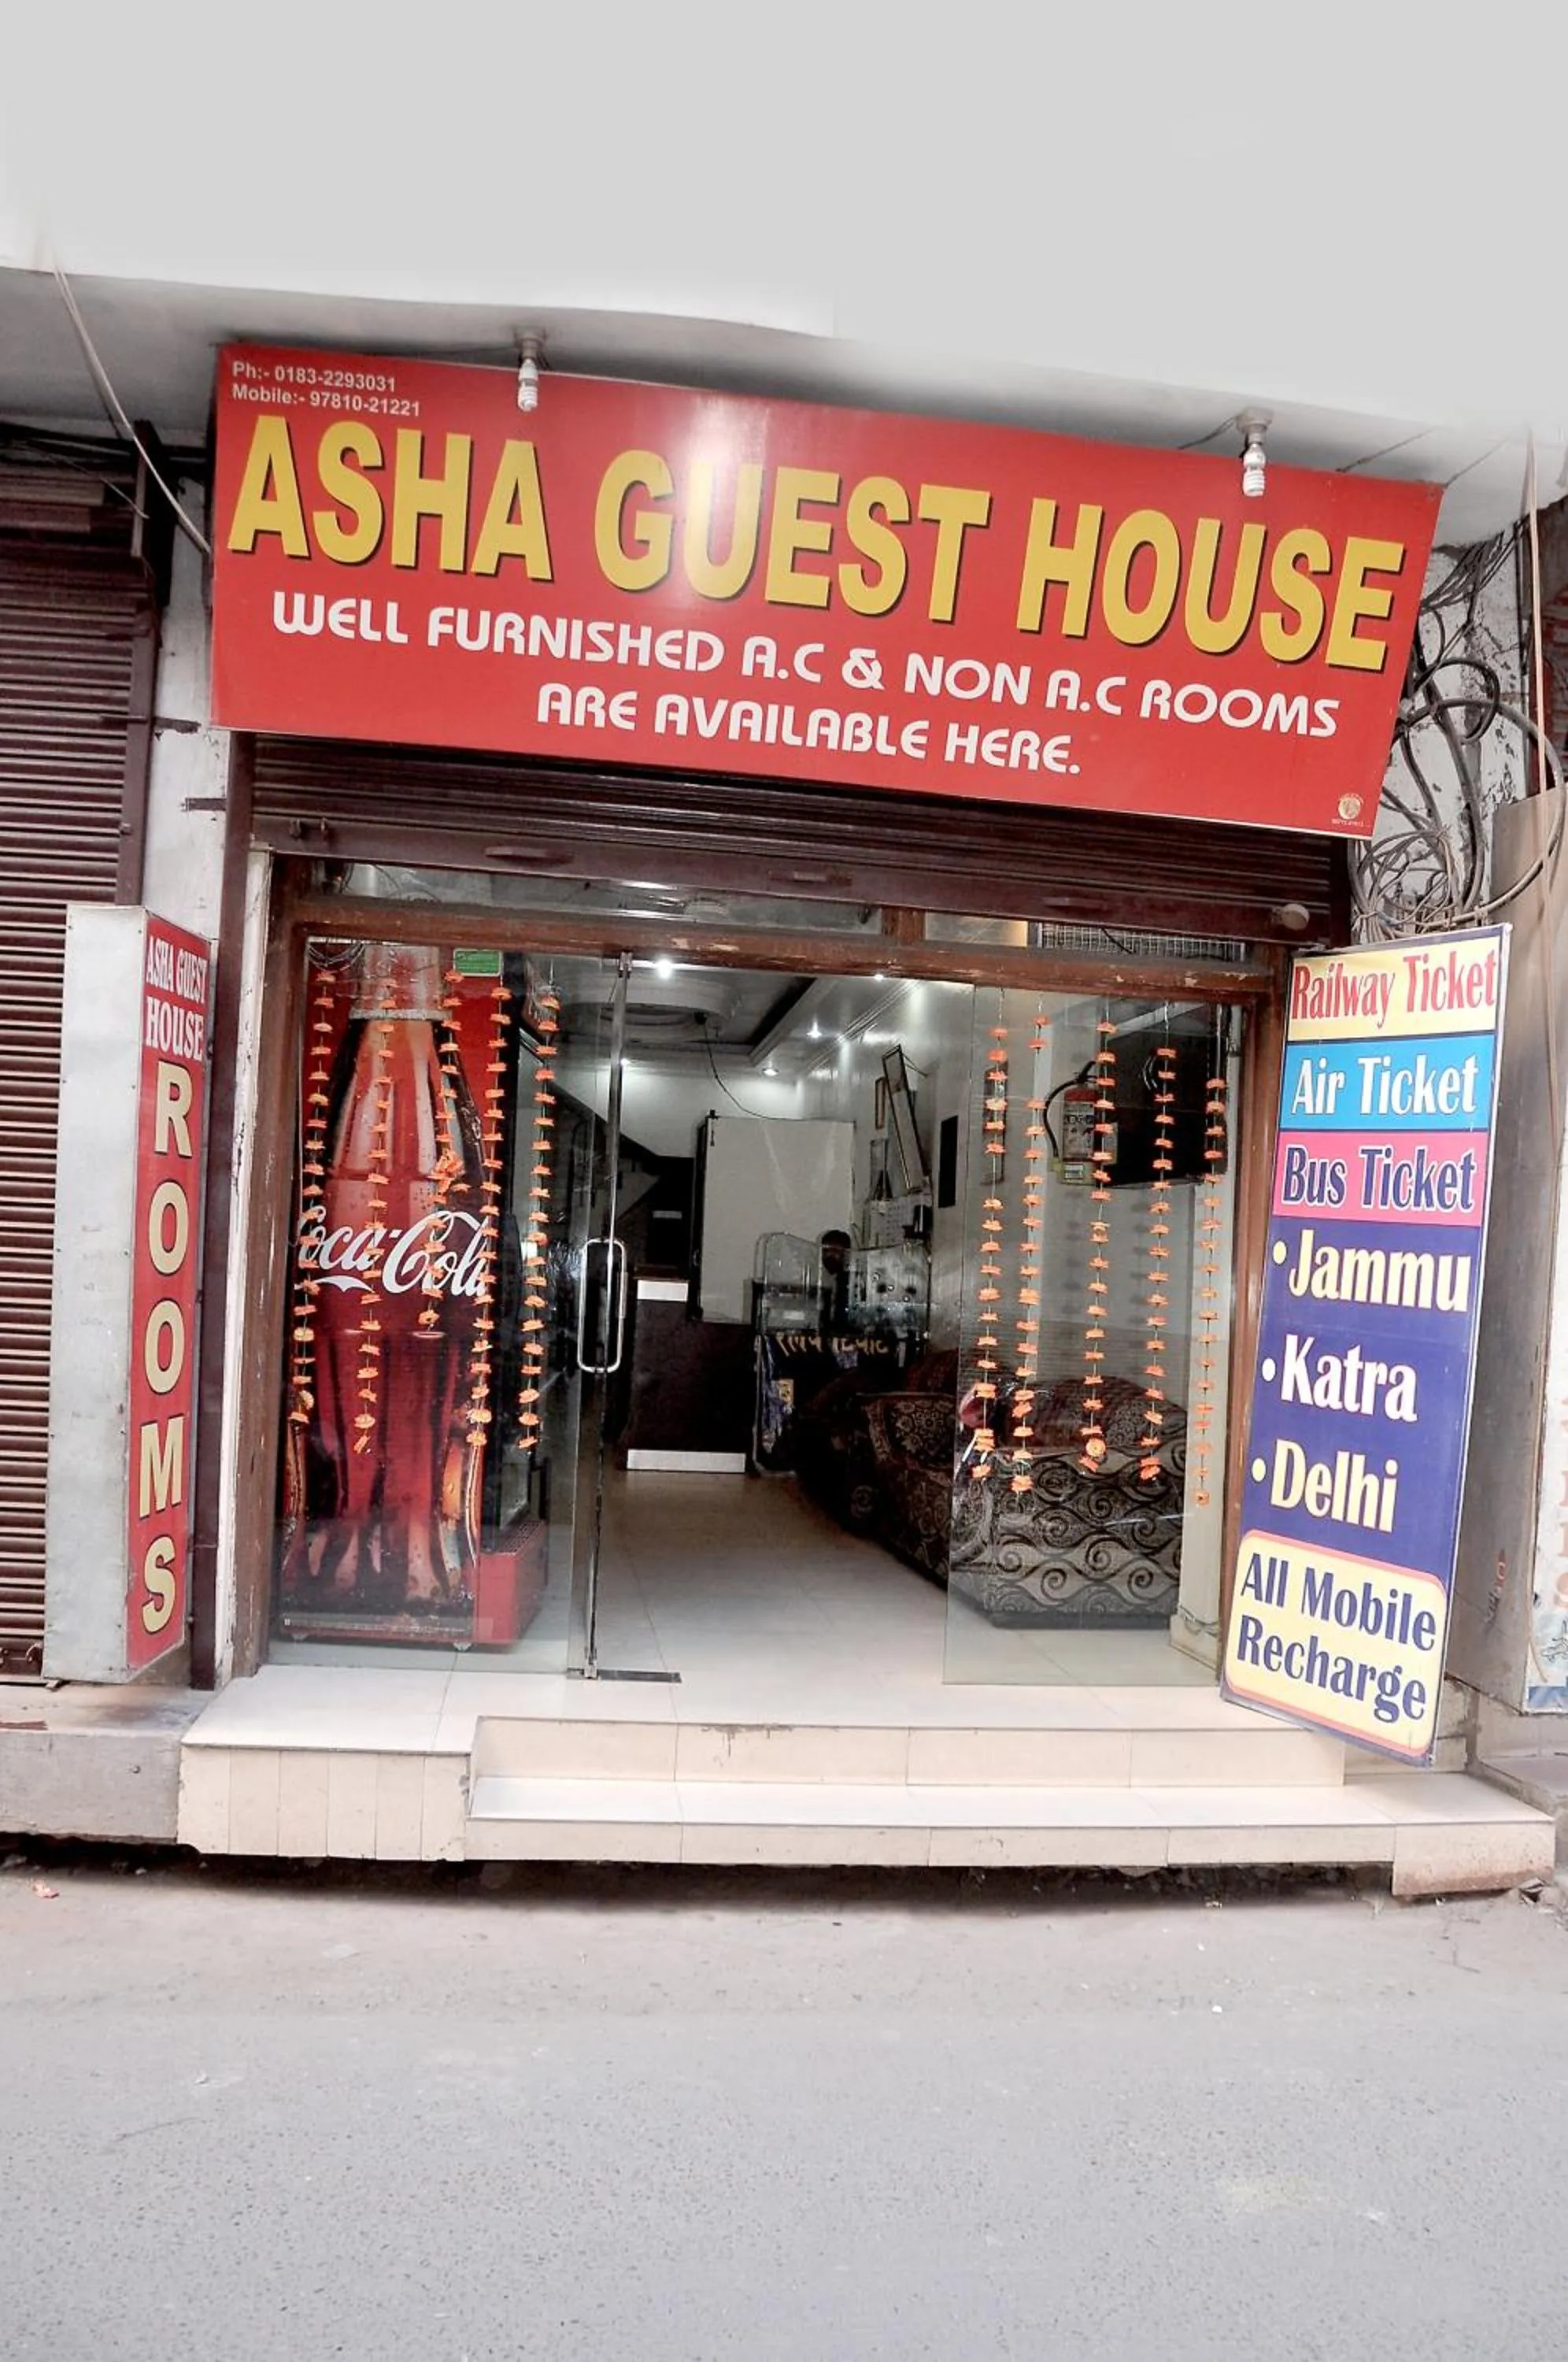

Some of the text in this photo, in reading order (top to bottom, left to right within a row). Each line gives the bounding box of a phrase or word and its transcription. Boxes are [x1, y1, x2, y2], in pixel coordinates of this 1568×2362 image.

[232, 361, 397, 393] Ph:- 0183-2293031
[232, 383, 420, 416] Mobile:- 97810-21221
[227, 415, 1406, 674] ASHA GUEST HOUSE
[273, 591, 1341, 738] WELL FURNISHED A.C & NON A.C ROOMS
[538, 682, 1082, 775] ARE AVAILABLE HERE.
[146, 935, 209, 1005] ASHA GUEST
[1291, 948, 1496, 1028] Railway Ticket
[146, 995, 205, 1061] HOUSE
[1291, 1053, 1479, 1116] Air Ticket
[1281, 1142, 1477, 1212] Bus Ticket
[1289, 1228, 1472, 1312] Jammu
[138, 1058, 193, 1635] ROOMS
[1281, 1334, 1418, 1423] Katra
[1270, 1438, 1399, 1534] Delhi
[1240, 1552, 1437, 1652] All Mobile
[1237, 1614, 1426, 1723] Recharge
